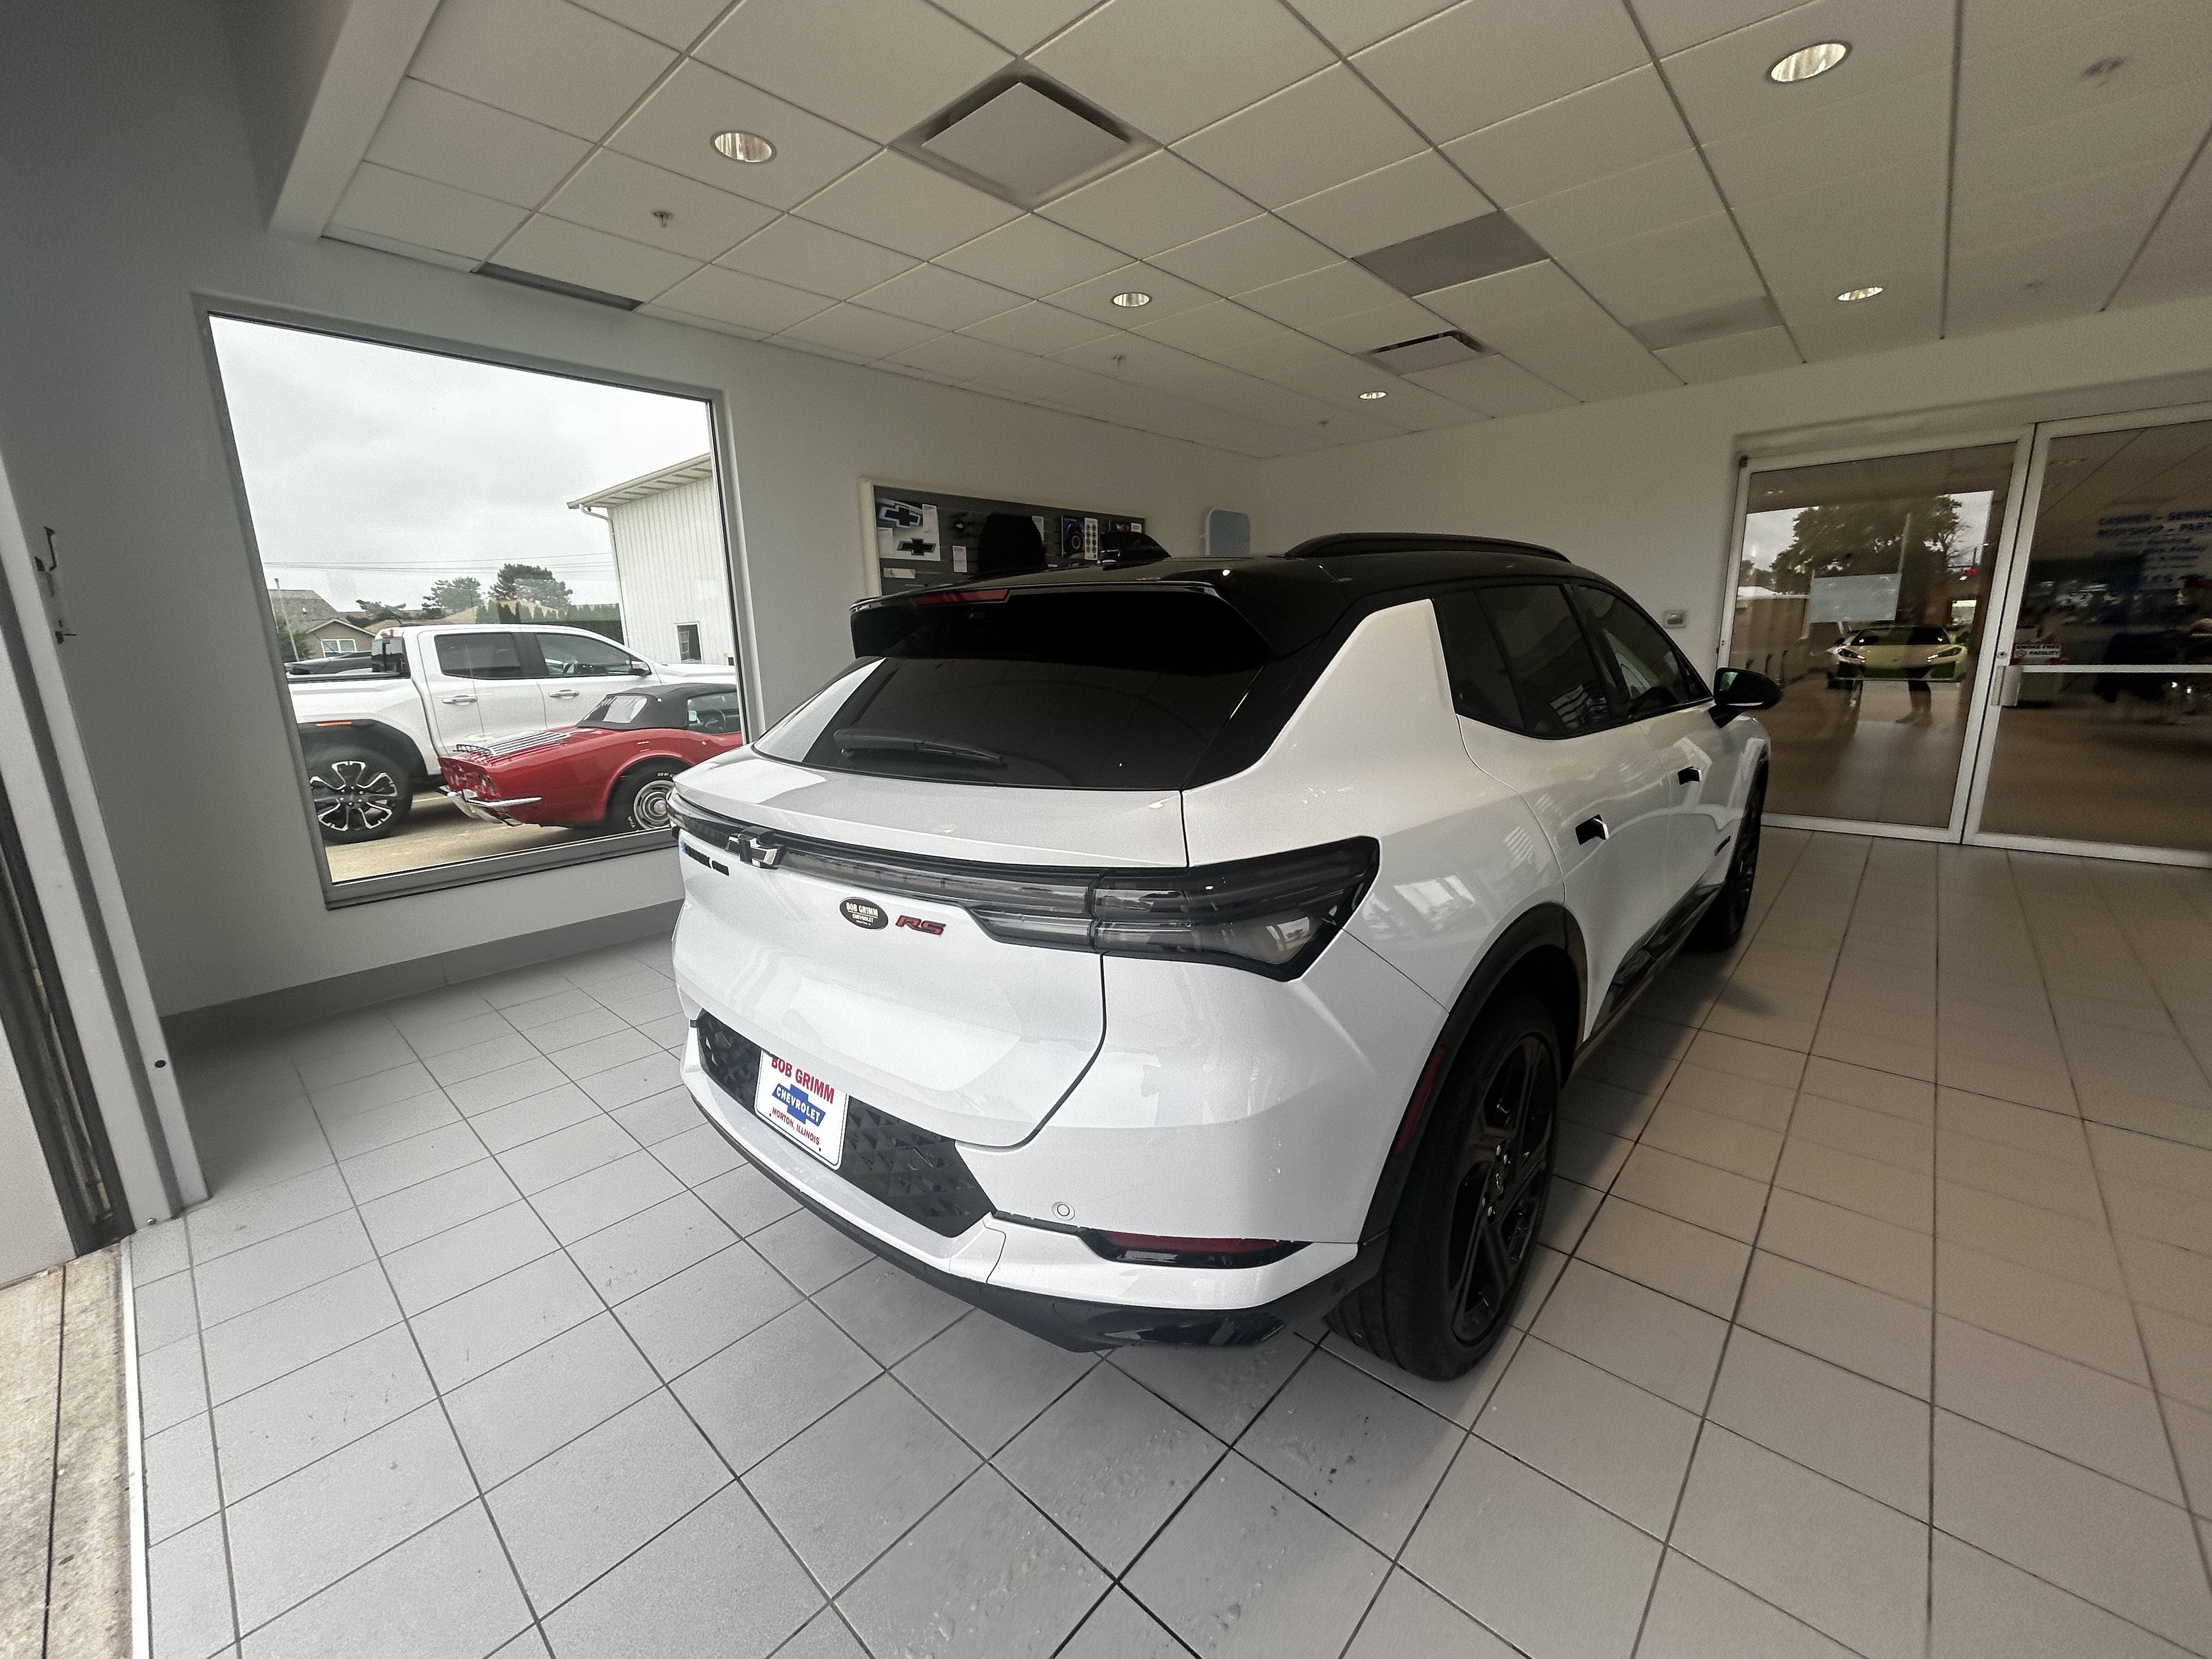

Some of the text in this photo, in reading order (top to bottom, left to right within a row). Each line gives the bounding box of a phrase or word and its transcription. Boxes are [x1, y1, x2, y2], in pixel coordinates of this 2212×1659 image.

[846, 902, 878, 917] BOB GRIMM
[852, 913, 874, 923] CHEVROLET
[895, 915, 946, 935] RS
[771, 1058, 835, 1104] BOB GRIMM
[776, 1086, 821, 1122] CHEVROLET
[771, 1107, 820, 1146] MORTON, ILLINOIS
